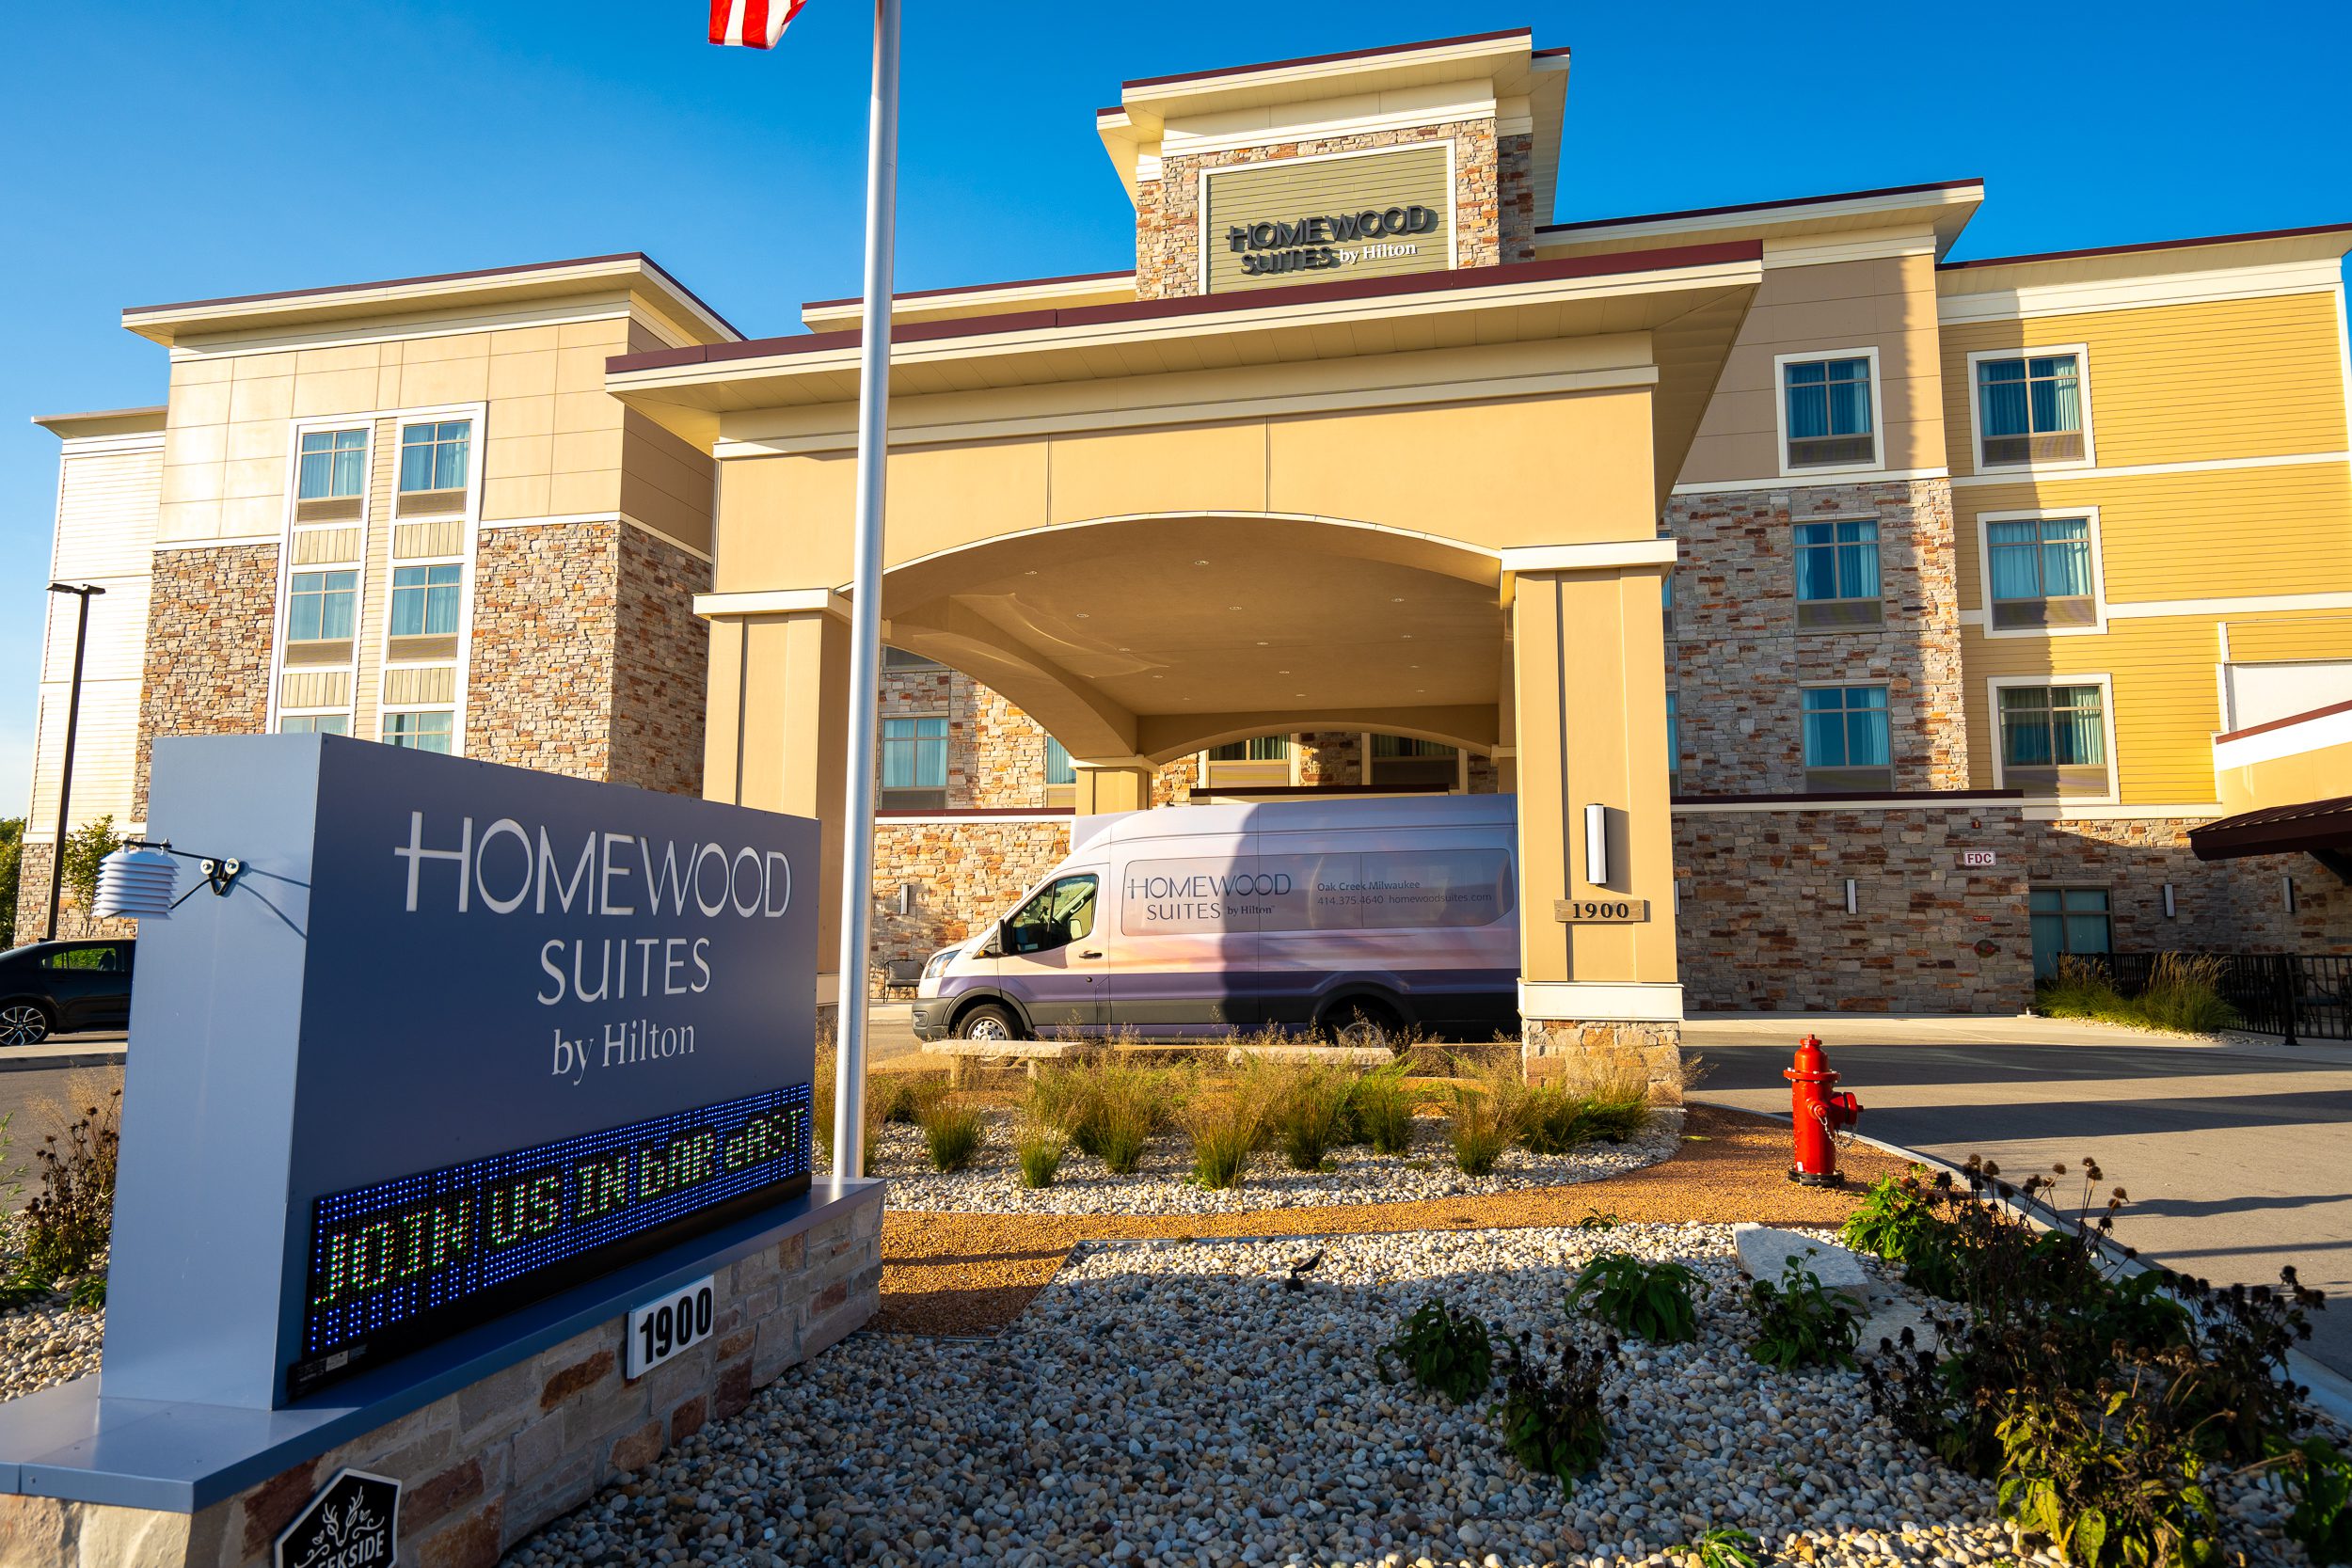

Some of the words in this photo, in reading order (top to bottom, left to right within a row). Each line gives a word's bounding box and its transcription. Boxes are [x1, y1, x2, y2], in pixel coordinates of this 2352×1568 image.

[1225, 204, 1429, 252] HOMEWOOD
[1240, 245, 1332, 275] SUITES
[1339, 247, 1359, 264] by
[1362, 243, 1418, 261] Hilton
[394, 811, 792, 919] HOMEWOOD
[1967, 853, 1992, 864] FDC
[1127, 873, 1292, 899] HOMEWOOD
[1317, 882, 1337, 892] Oak
[1339, 881, 1366, 891] Creek
[1369, 880, 1421, 891] Milwaukee
[1317, 895, 1384, 906] 414.375.4640
[1389, 893, 1492, 904] homewoodsuites.com
[1147, 902, 1221, 921] SUITES
[1227, 905, 1239, 917] by
[1572, 903, 1629, 919] 1900
[537, 937, 712, 1006] SUITES
[551, 1028, 594, 1086] by
[602, 1019, 696, 1068] Hilton
[313, 1199, 471, 1306] JOIN
[491, 1175, 561, 1244] US
[577, 1155, 628, 1219] IN
[639, 1286, 713, 1365] 1900
